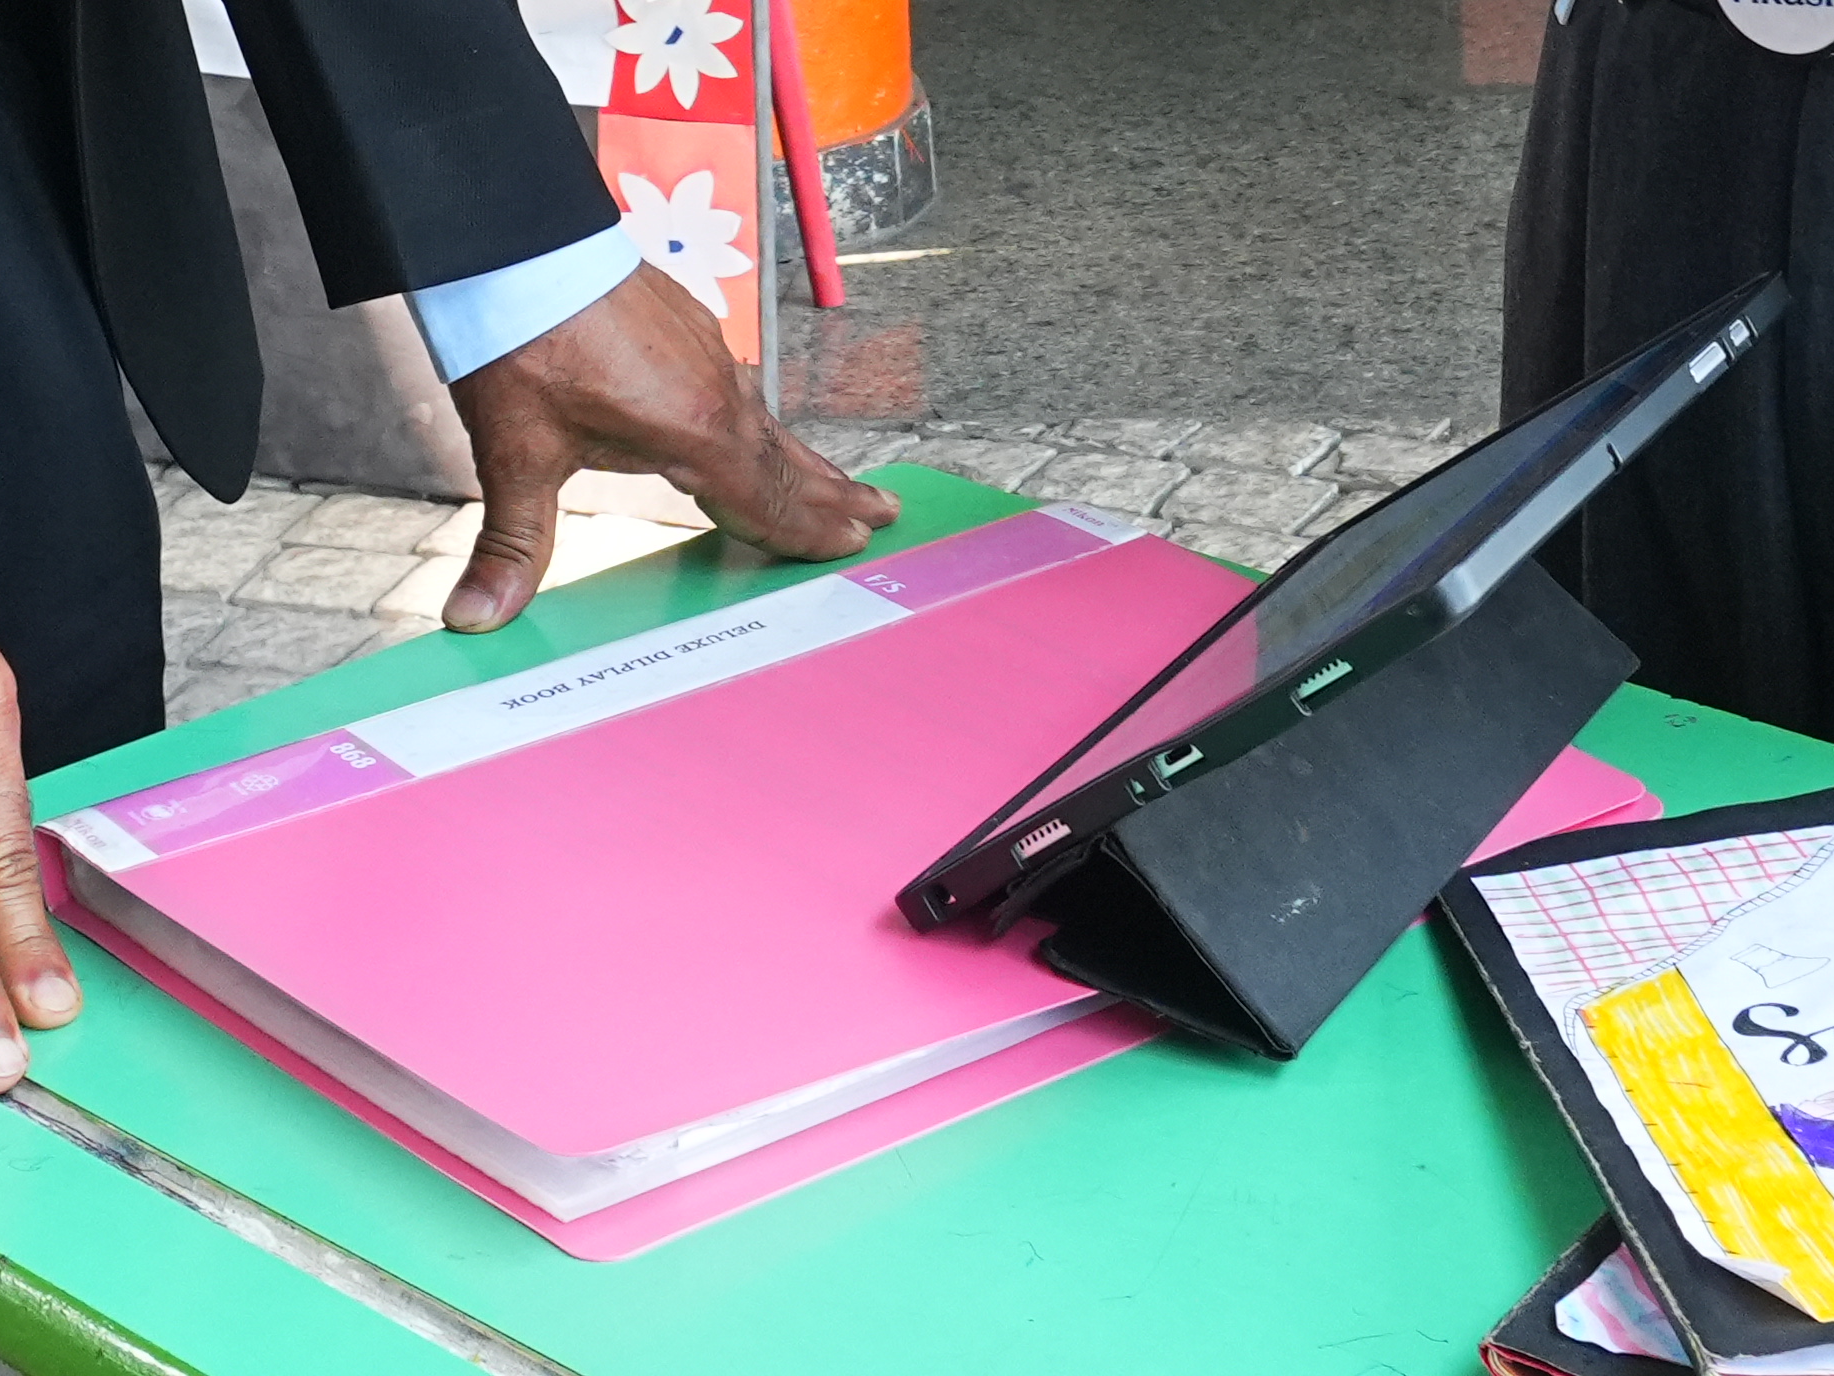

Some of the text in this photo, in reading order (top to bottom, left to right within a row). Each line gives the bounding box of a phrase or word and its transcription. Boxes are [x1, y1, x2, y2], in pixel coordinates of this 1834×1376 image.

[864, 573, 907, 594] F/S
[674, 620, 768, 654] DELUXE
[499, 682, 574, 710] BOOK
